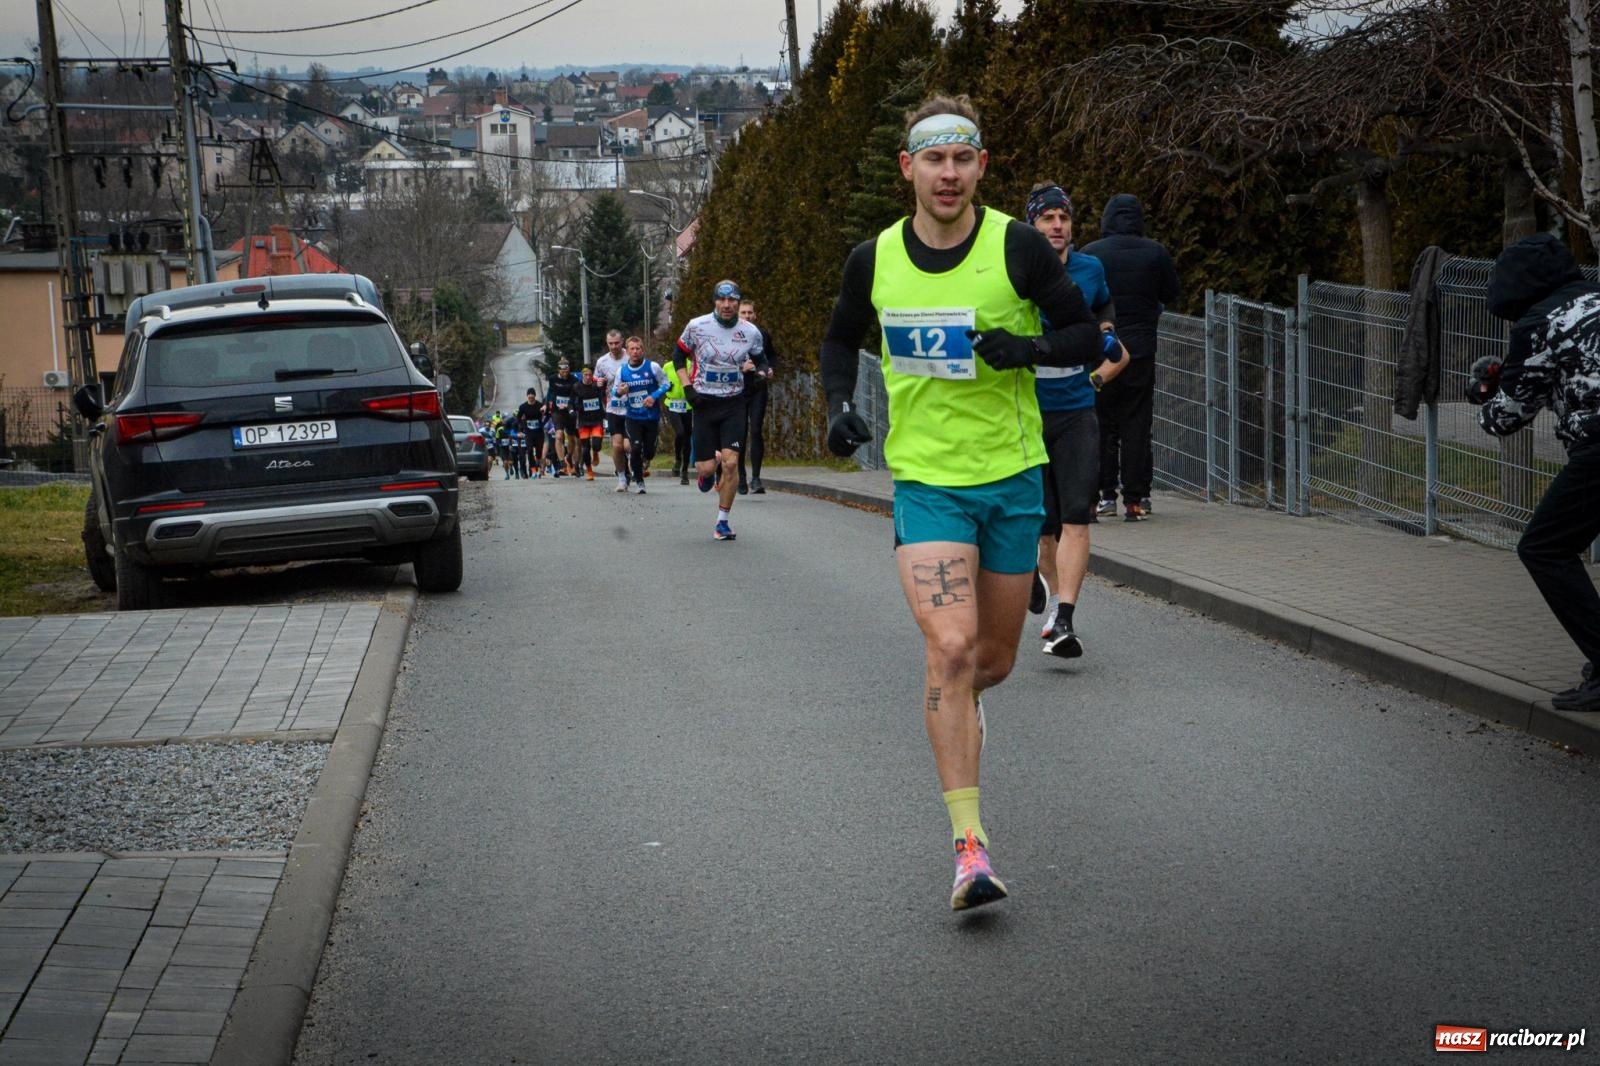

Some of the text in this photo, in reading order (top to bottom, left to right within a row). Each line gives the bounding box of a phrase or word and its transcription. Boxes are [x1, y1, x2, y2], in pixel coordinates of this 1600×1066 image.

[908, 327, 947, 357] 12
[716, 374, 730, 382] 16
[245, 422, 332, 444] OP 1239P
[265, 460, 315, 469] Ateca
